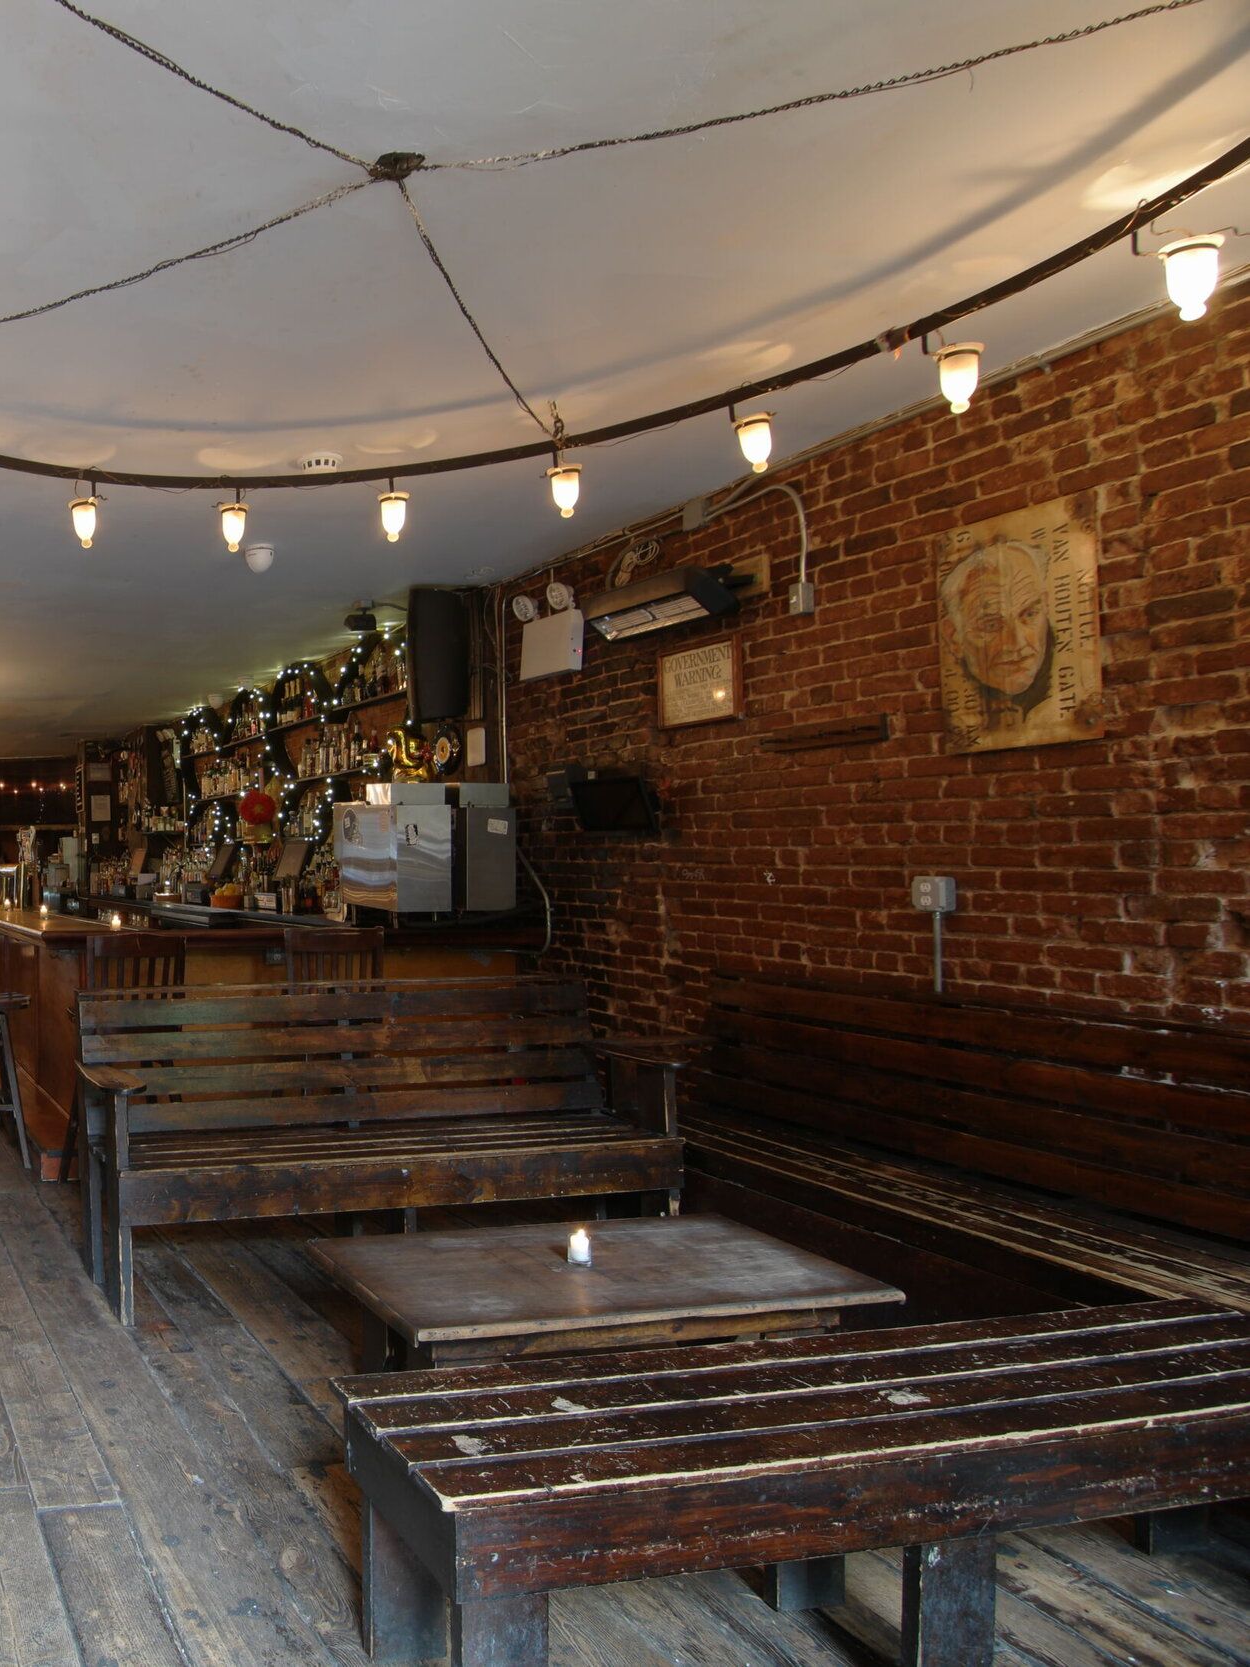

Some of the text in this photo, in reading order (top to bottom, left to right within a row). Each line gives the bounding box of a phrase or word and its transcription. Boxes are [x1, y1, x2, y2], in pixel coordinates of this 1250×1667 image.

[1052, 522, 1077, 718] VAN HOUTEN GATE
[1076, 568, 1097, 648] NOTICE
[663, 644, 732, 674] GOVERNMENT
